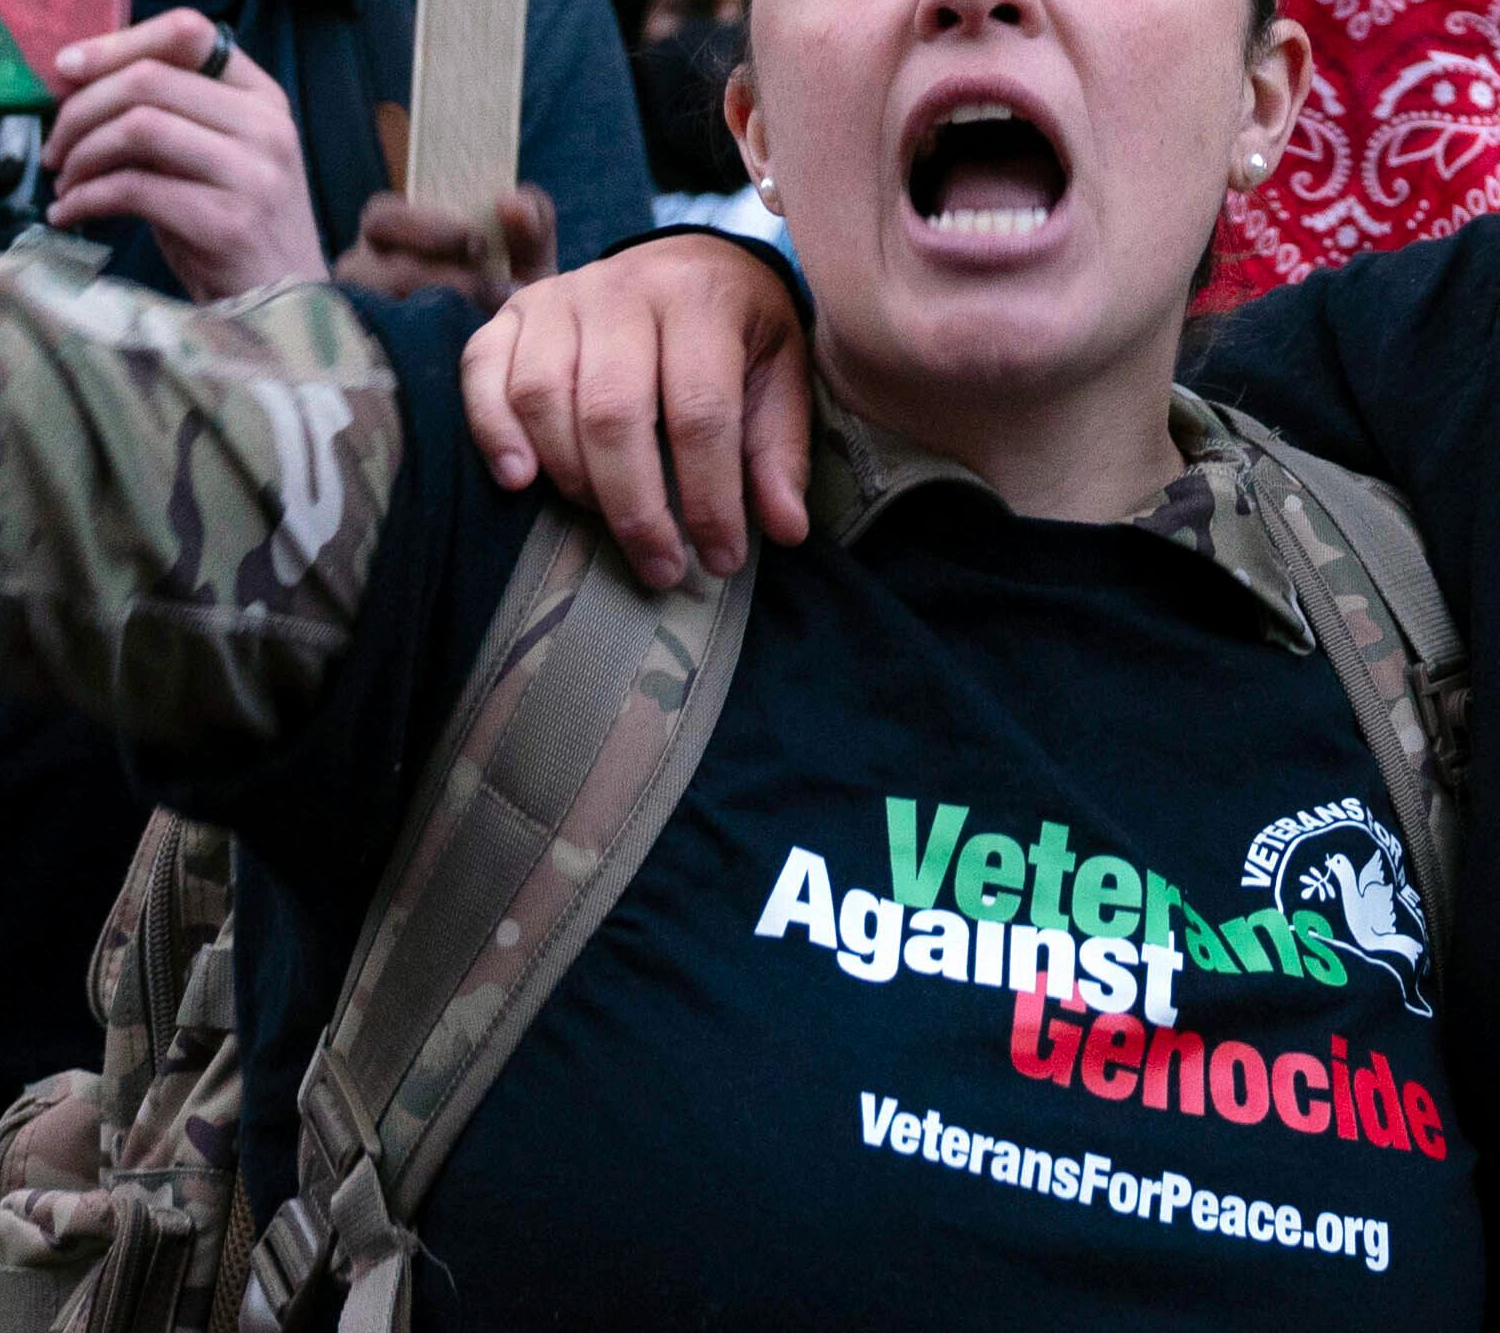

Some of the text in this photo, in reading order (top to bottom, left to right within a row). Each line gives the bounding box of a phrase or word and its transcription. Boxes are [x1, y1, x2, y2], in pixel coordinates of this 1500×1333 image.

[885, 795, 1349, 987] Veterans
[1241, 797, 1365, 887] VETERANS
[754, 845, 1183, 1026] Against
[1010, 970, 1448, 1162] Genocide
[860, 1091, 1389, 1273] VeteransForPeace.org
